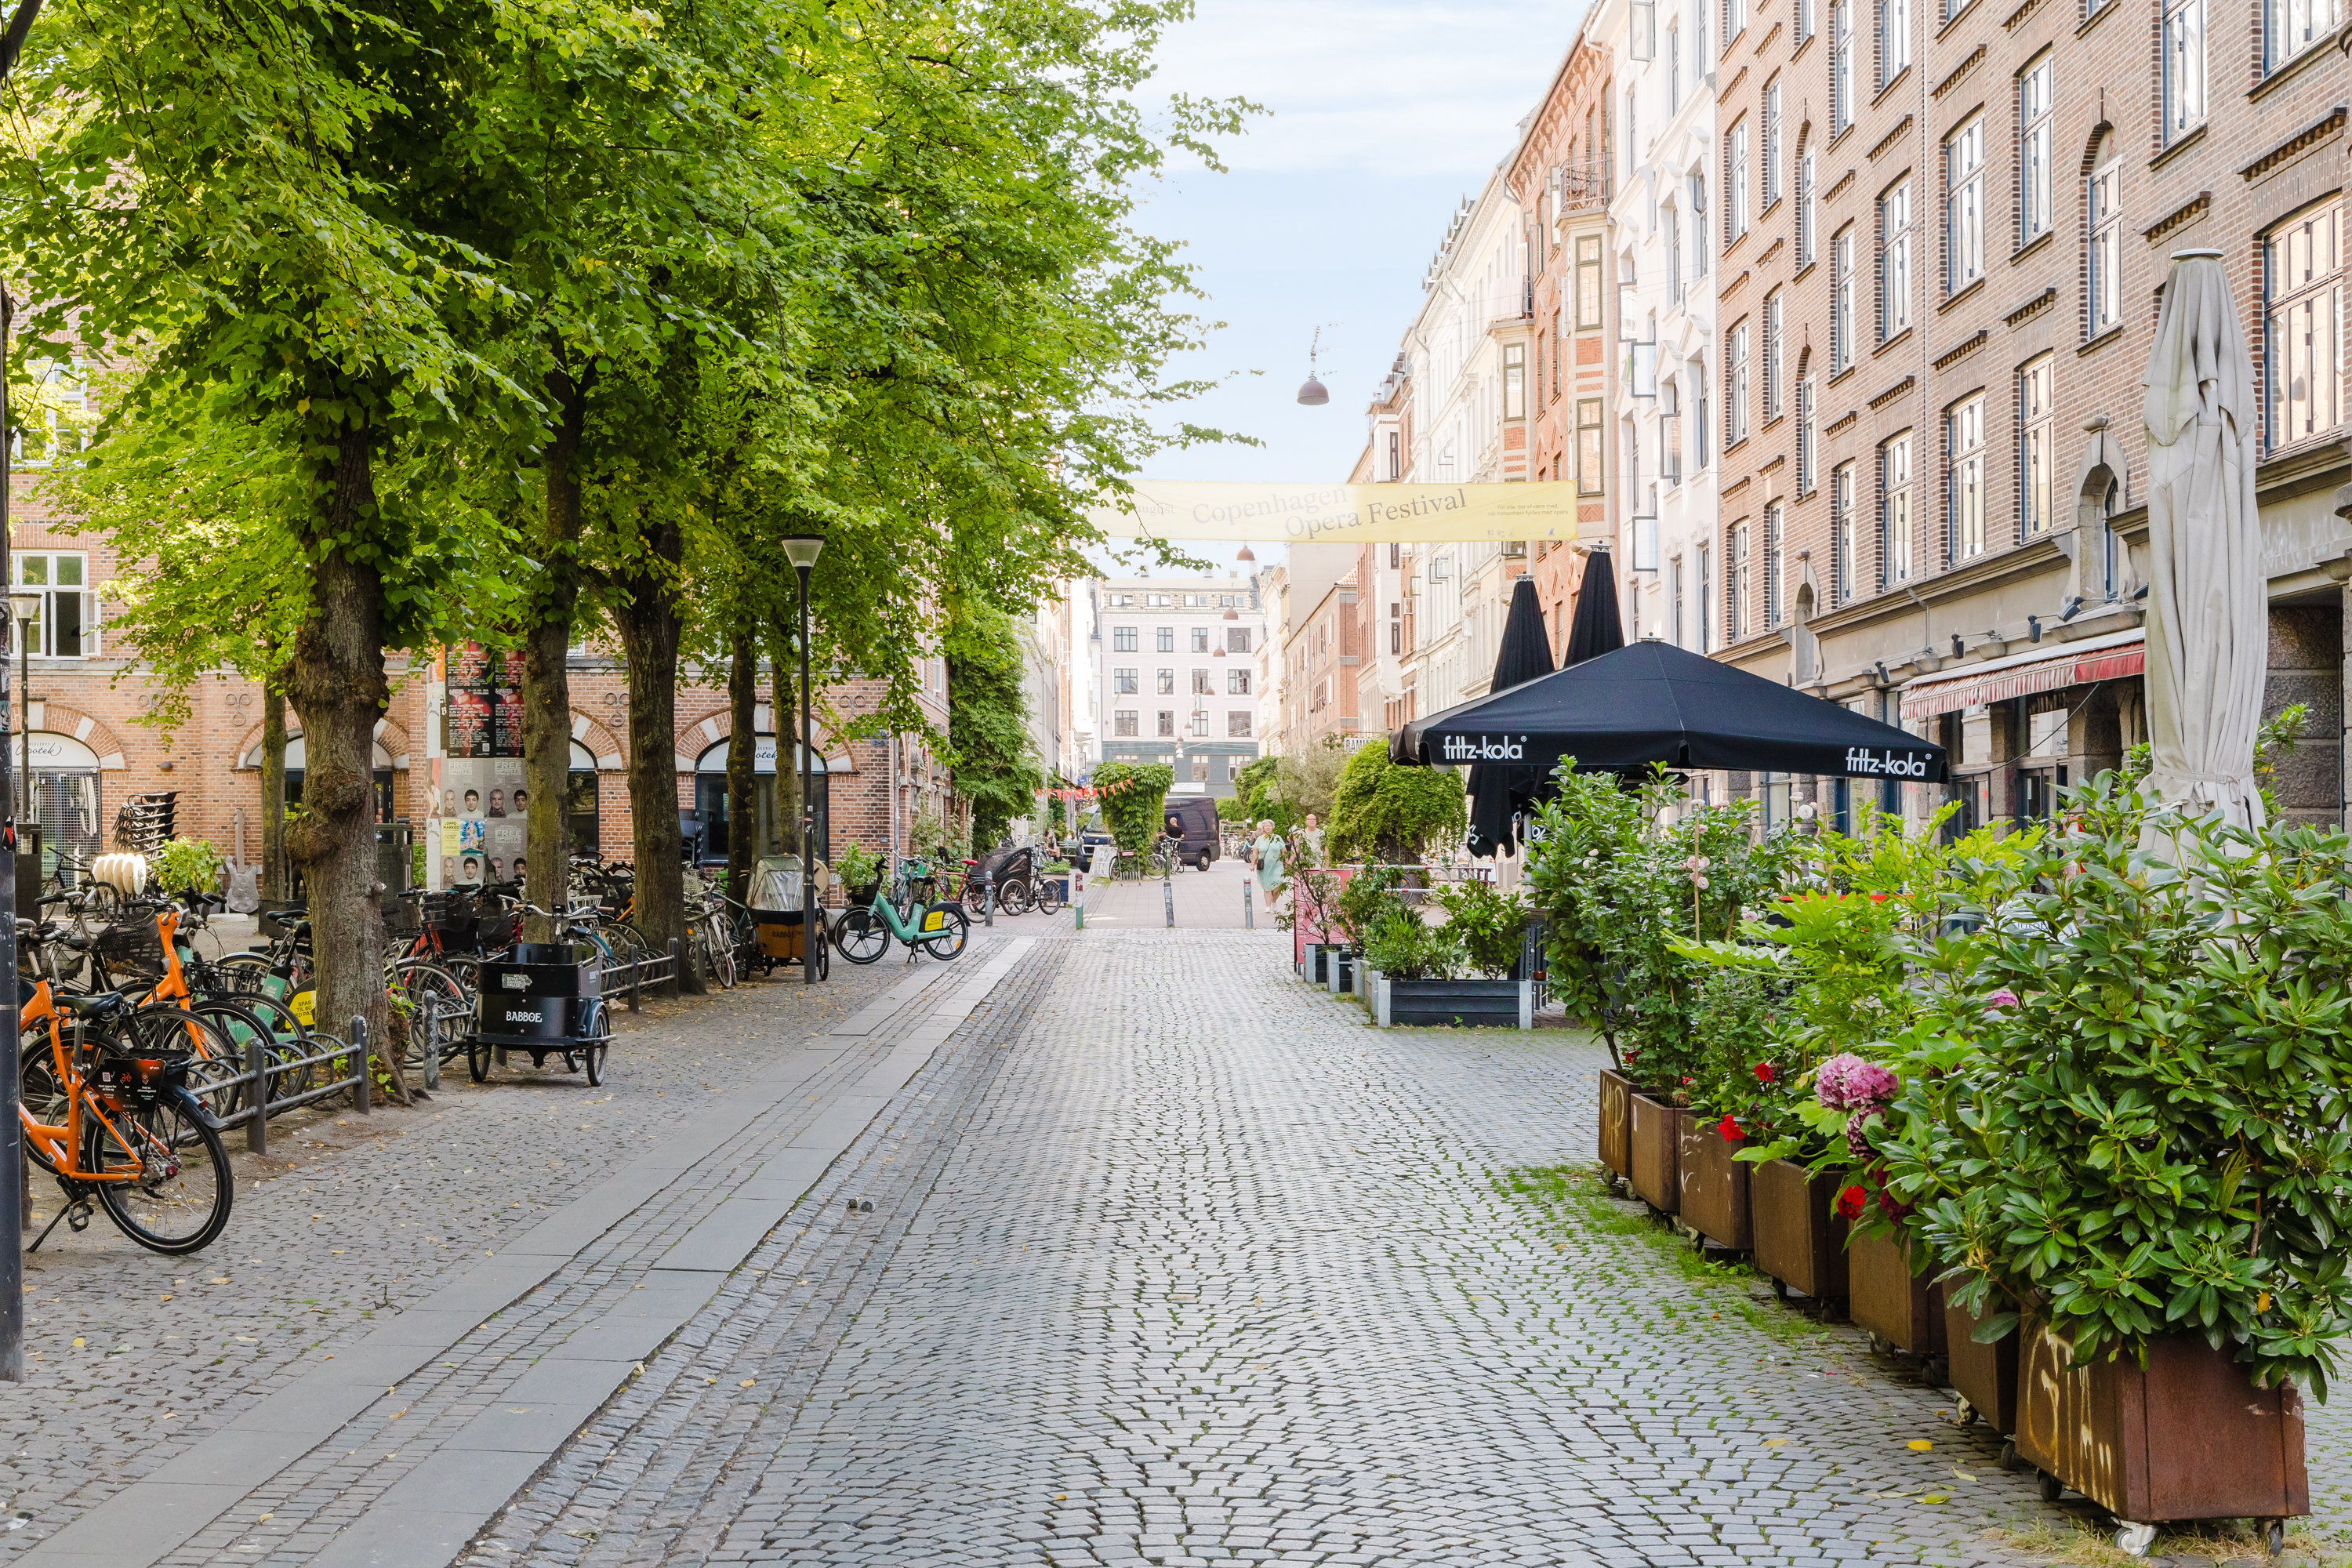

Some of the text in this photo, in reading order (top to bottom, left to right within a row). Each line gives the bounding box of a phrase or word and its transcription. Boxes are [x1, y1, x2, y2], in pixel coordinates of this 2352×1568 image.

[1192, 488, 1348, 525] Copenhagen
[1285, 488, 1468, 539] Opera Festival
[506, 1011, 543, 1022] BABBOE
